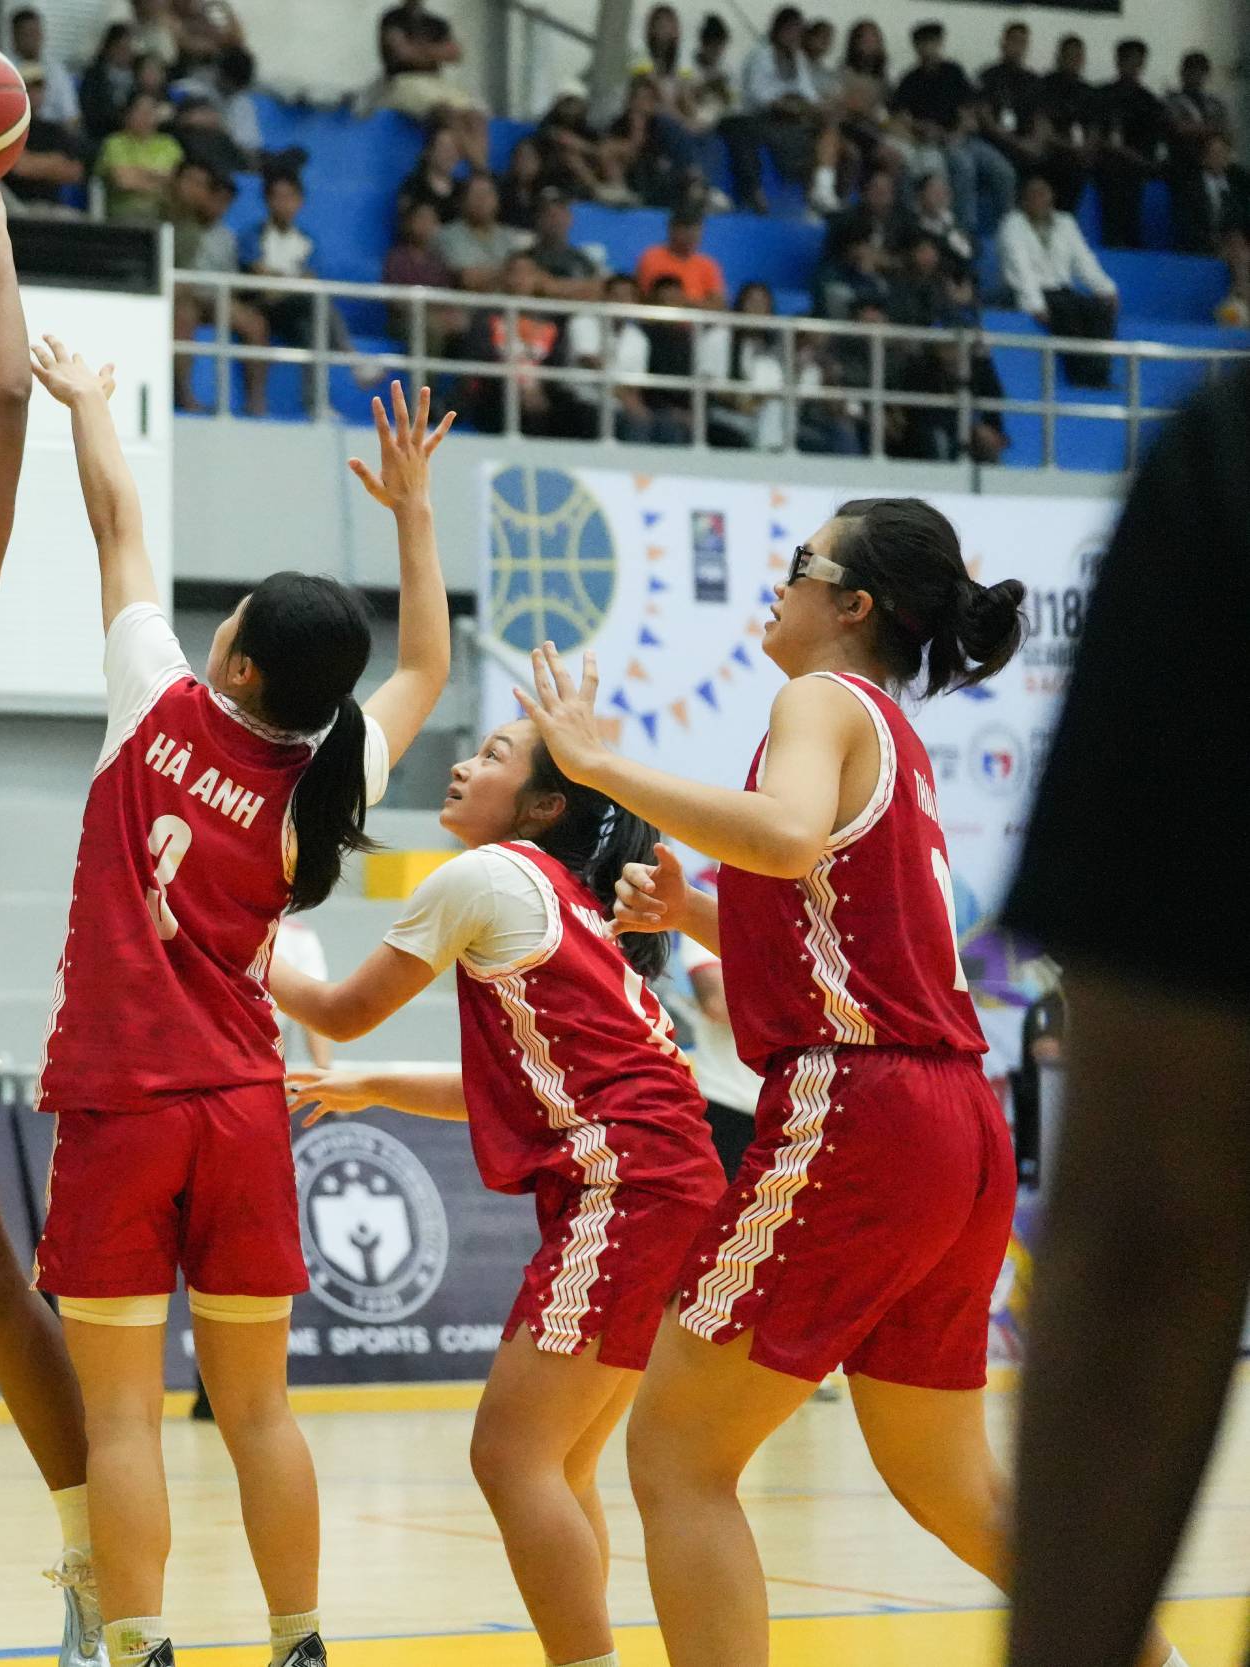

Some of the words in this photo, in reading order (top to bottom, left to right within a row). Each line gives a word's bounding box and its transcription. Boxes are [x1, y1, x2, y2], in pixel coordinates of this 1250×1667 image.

[145, 732, 193, 785] HÀ
[187, 767, 266, 830] ANH
[329, 1325, 431, 1355] SPORTS
